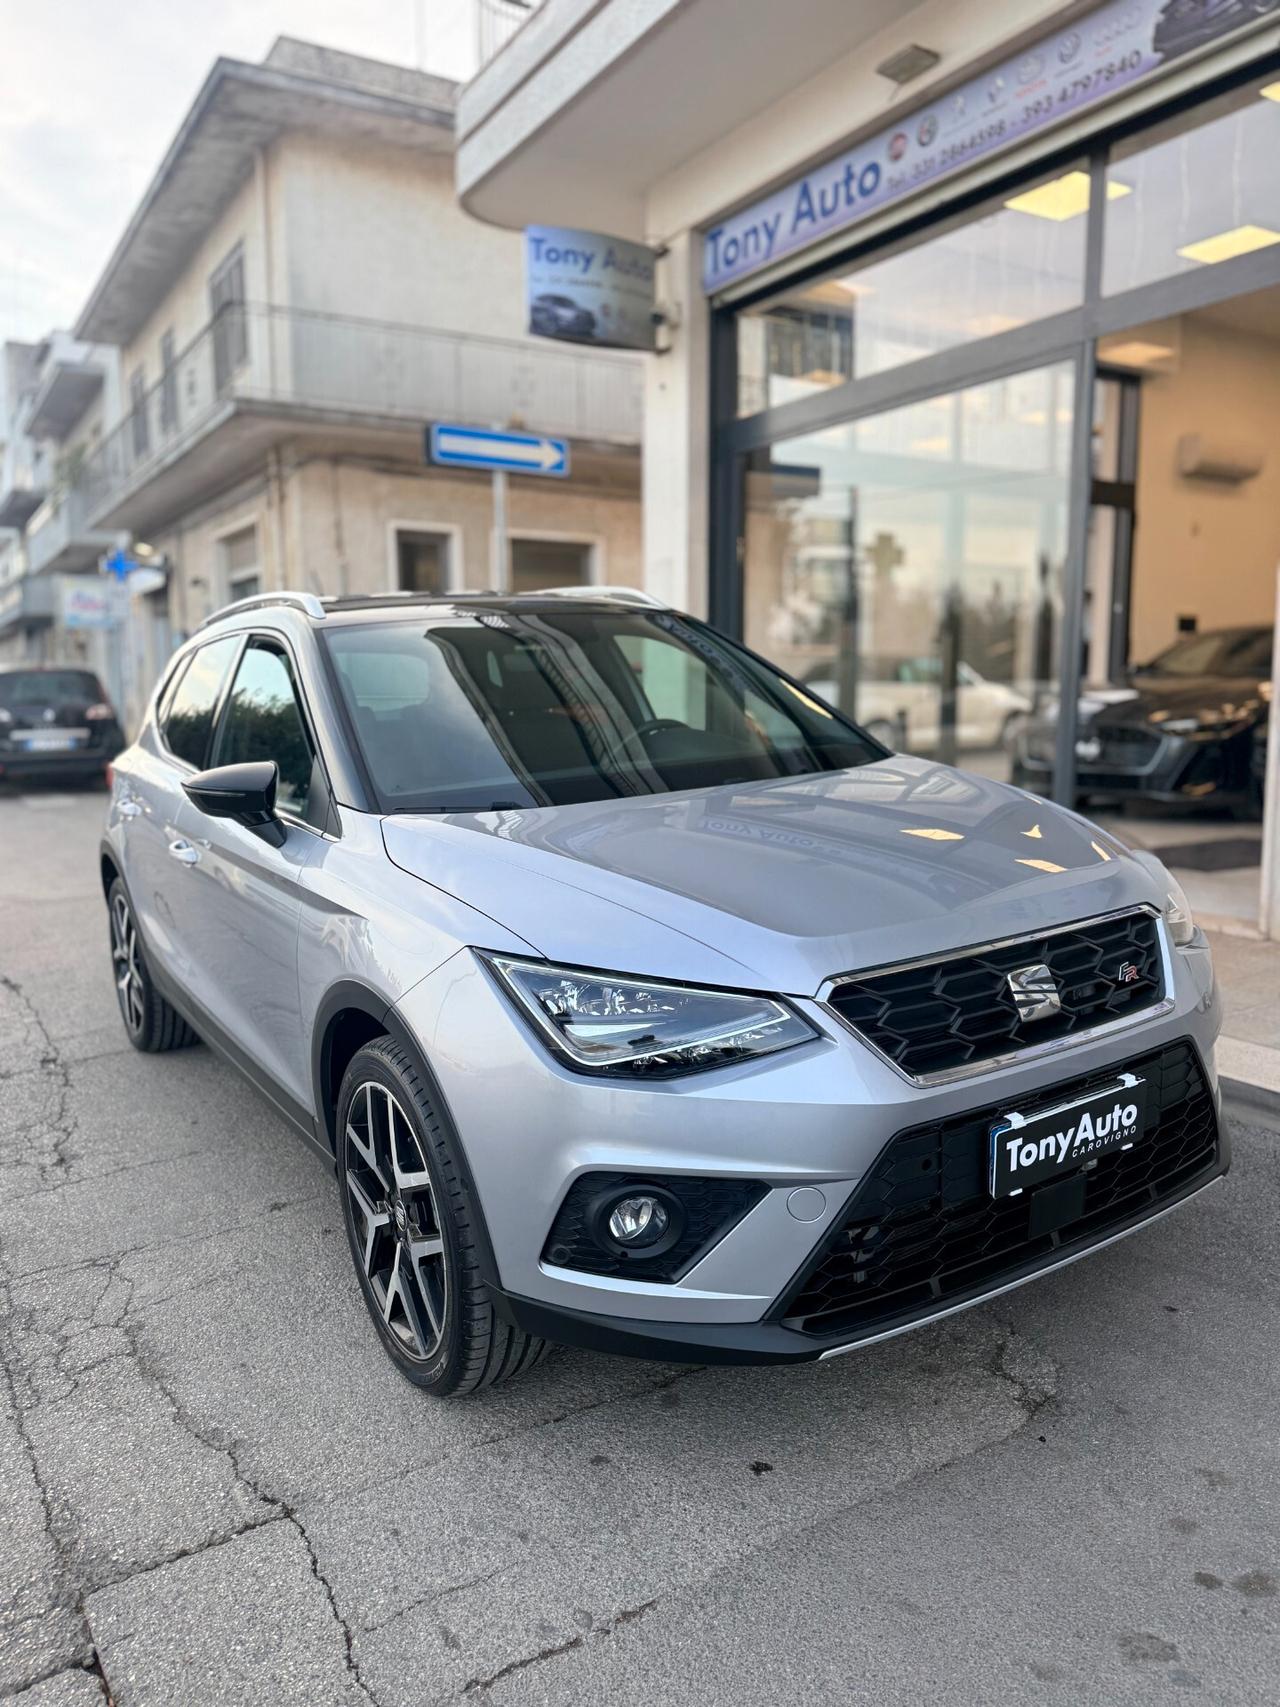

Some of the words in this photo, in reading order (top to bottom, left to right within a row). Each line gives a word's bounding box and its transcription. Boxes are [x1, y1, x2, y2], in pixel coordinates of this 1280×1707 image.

[707, 212, 781, 273] Tony
[791, 161, 881, 235] Auto
[531, 237, 596, 275] Tony
[601, 247, 654, 282] Auto
[1118, 961, 1140, 983] FR
[1006, 1103, 1138, 1172] TonyAuto
[1072, 1124, 1137, 1159] CAROVIGNO
